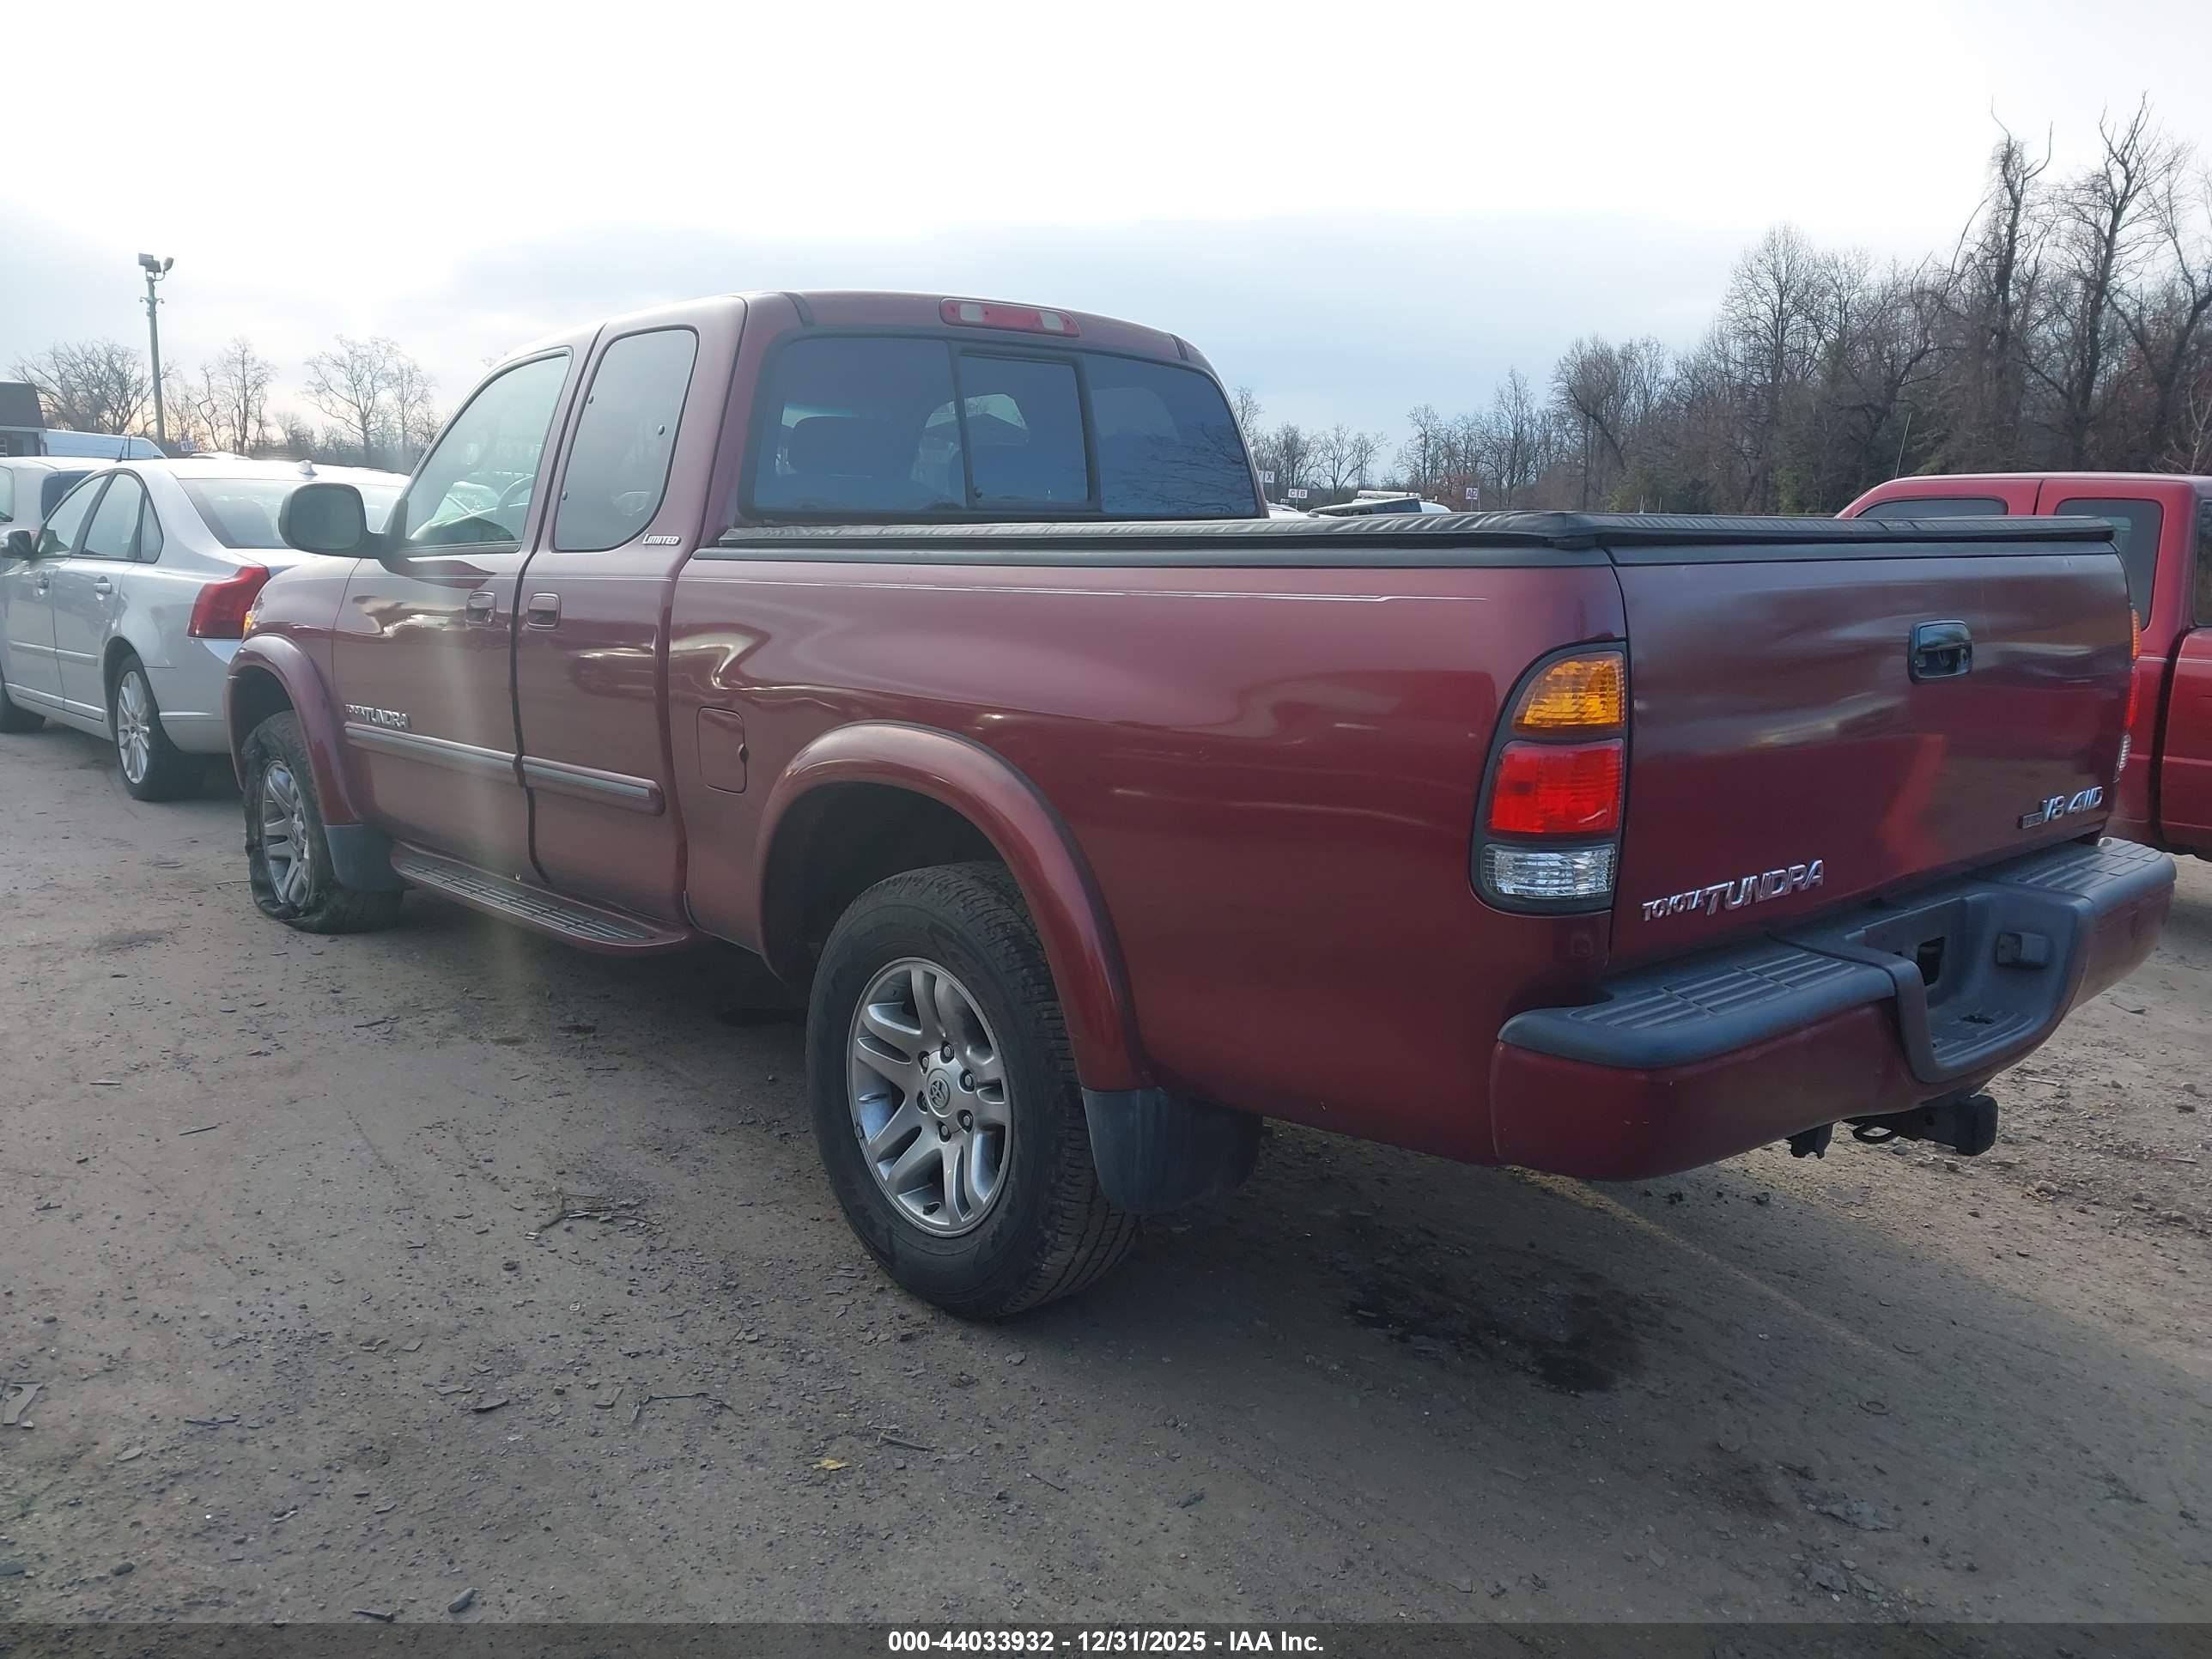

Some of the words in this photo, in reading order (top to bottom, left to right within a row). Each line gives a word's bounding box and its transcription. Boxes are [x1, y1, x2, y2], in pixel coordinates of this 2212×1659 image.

[641, 533, 680, 544] LIMITED
[364, 707, 406, 727] TUNDRA
[1642, 890, 1706, 921] TOYOTA
[1705, 859, 1825, 916] TUNDRA
